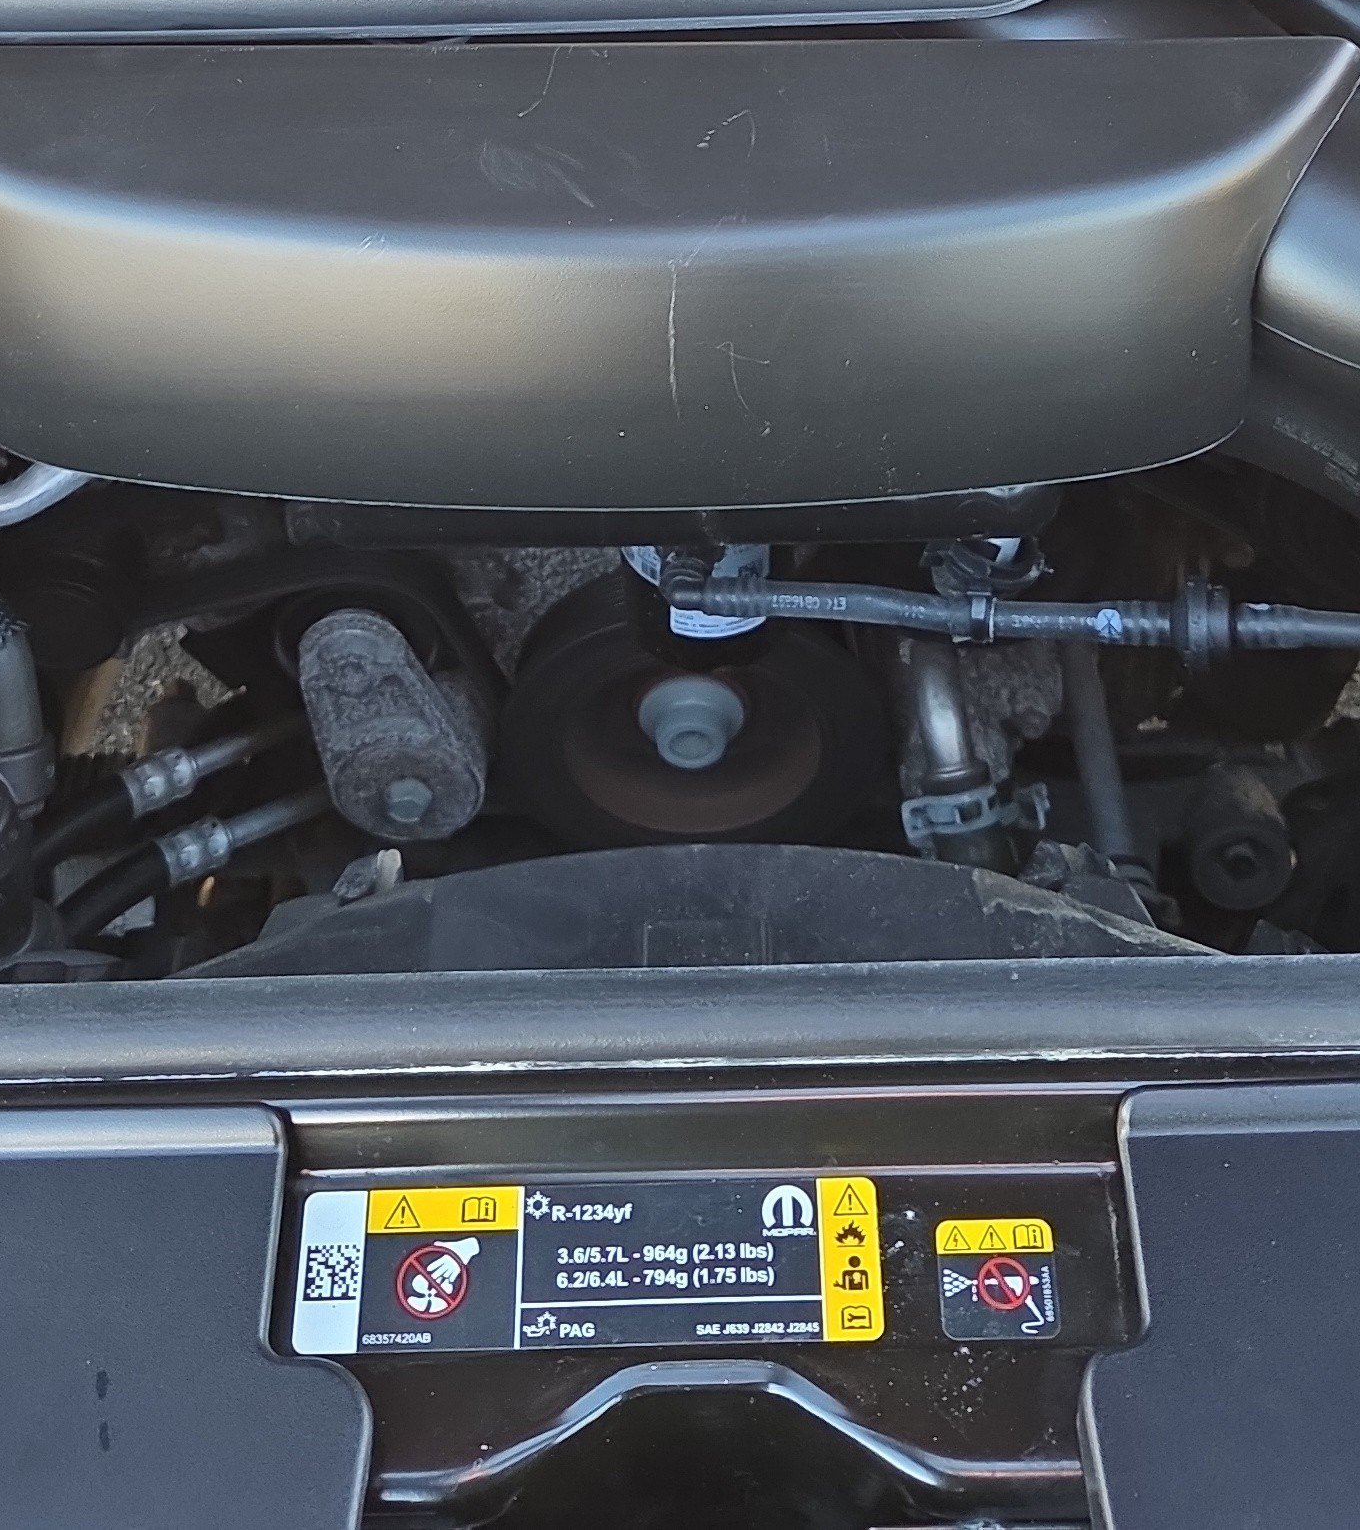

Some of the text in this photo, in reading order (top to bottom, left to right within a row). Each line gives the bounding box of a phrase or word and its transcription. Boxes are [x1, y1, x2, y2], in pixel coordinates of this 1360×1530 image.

[551, 1203, 633, 1224] R-1234yf
[557, 1246, 629, 1264] 3.6/5.7L
[643, 1245, 688, 1264] 964g
[692, 1243, 736, 1263] (2.13
[740, 1242, 773, 1262] lbs)
[557, 1270, 629, 1288] 6.2/6.4L
[643, 1269, 688, 1288] 794g
[692, 1267, 736, 1288] (1.75
[741, 1266, 775, 1287] lbs)
[361, 1332, 432, 1345] 68357420AB
[559, 1322, 820, 1338] PAG SAE J639 J2842 J2845
